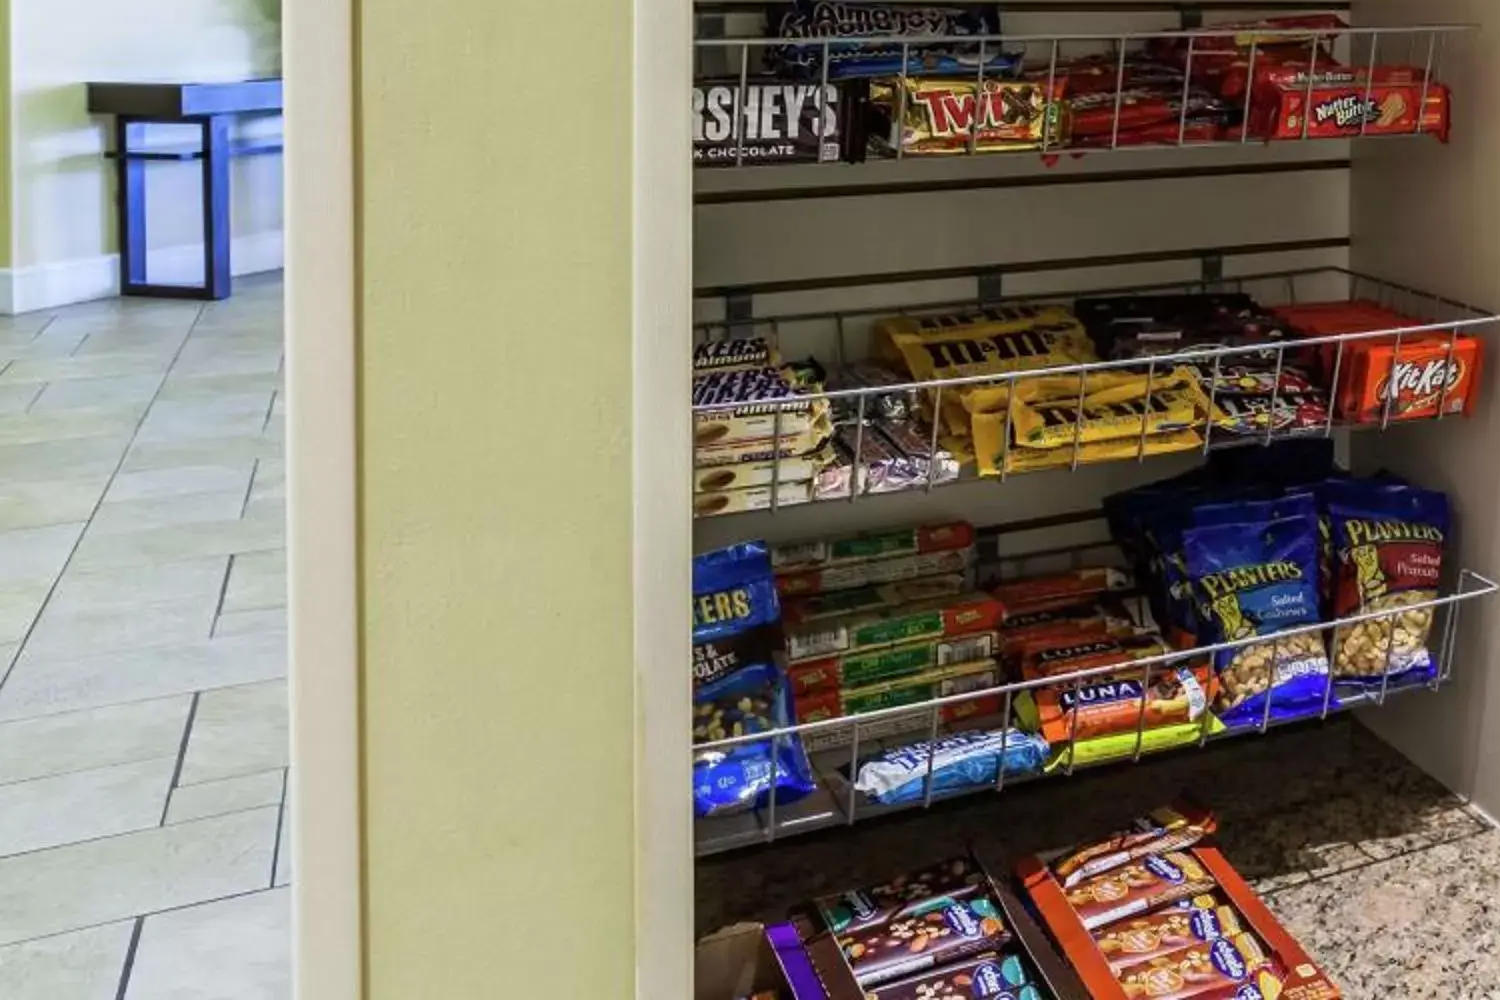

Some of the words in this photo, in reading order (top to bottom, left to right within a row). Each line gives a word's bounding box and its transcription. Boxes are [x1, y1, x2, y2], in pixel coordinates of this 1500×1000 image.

[1346, 519, 1443, 544] PLANTERS
[1201, 561, 1302, 599] PLANTERS
[1063, 682, 1141, 706] LUNA
